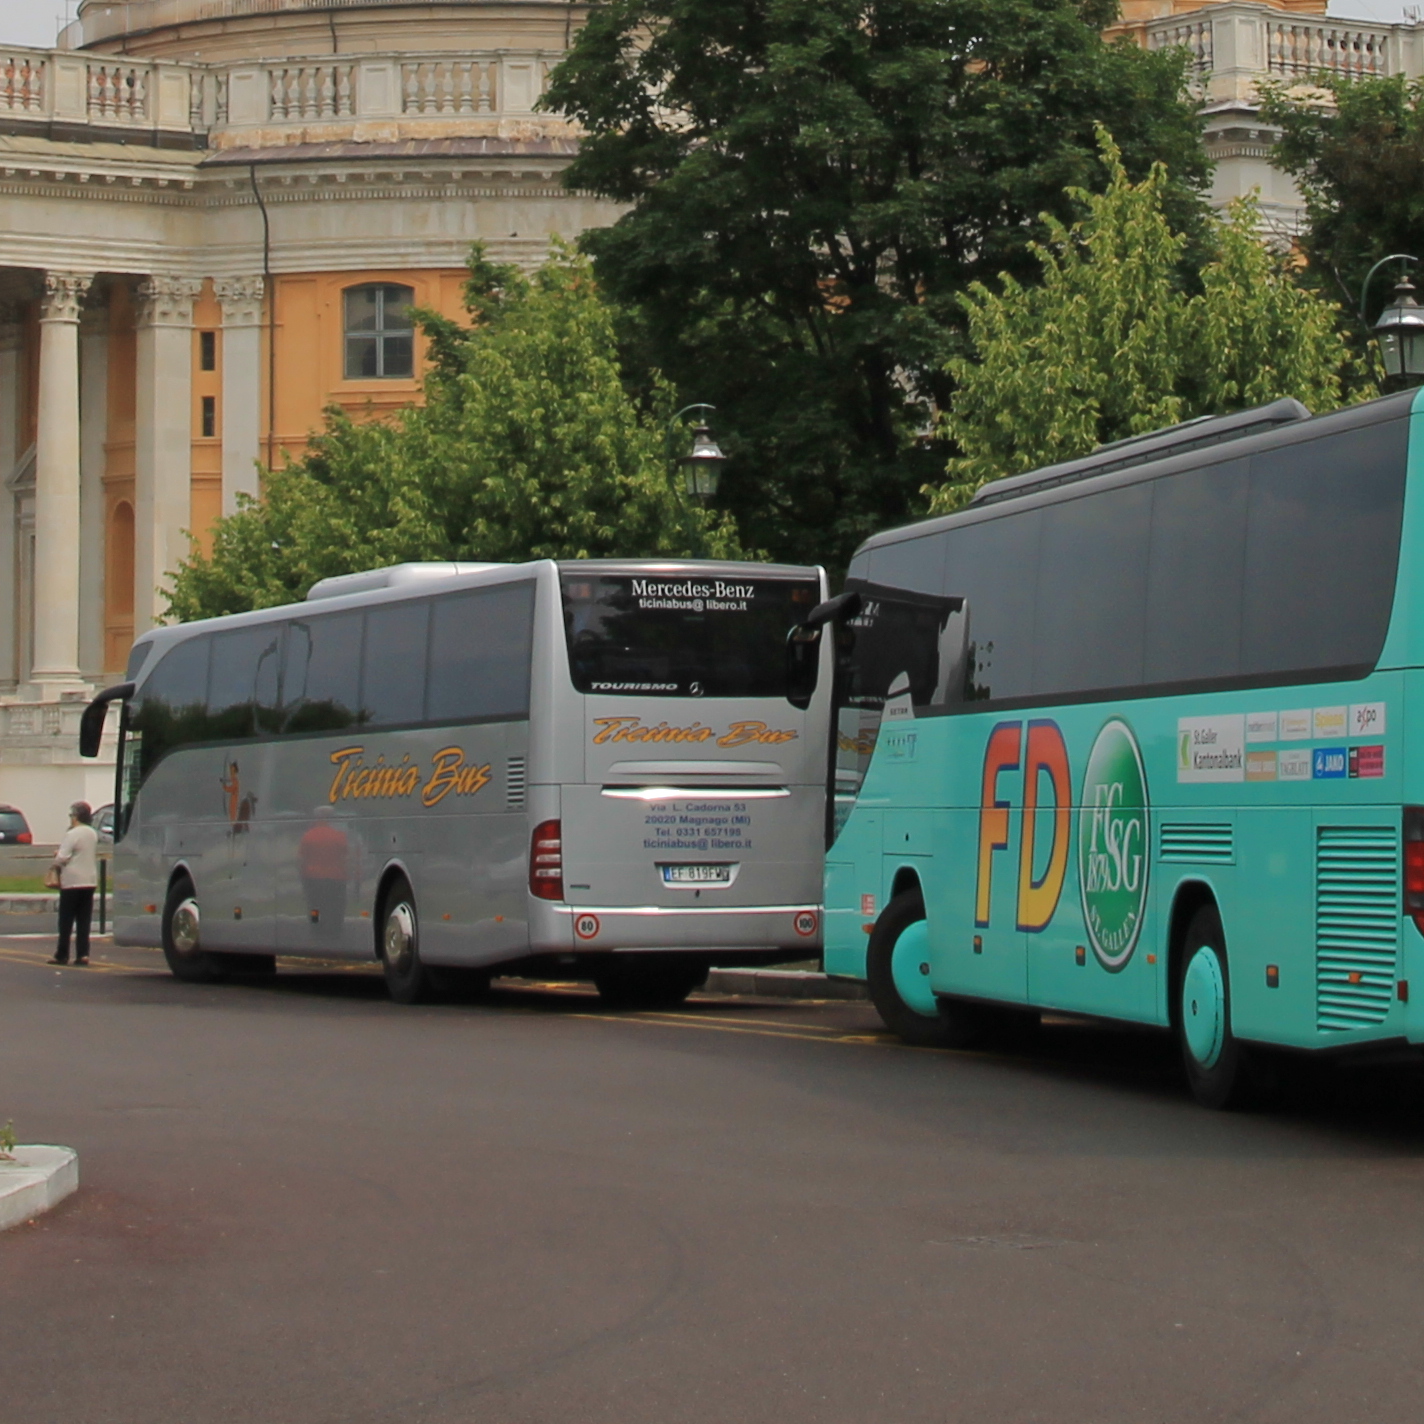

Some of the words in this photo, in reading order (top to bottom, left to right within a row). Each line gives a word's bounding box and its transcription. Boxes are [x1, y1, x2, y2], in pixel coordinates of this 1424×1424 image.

[631, 579, 755, 598] Mercedes-Benz
[591, 681, 678, 691] TOURISMO
[593, 717, 716, 744] Ticinia
[716, 721, 799, 749] Bus
[1194, 748, 1243, 769] Kantonalbank
[1325, 754, 1344, 772] JAKO
[329, 745, 420, 804] Ticinia
[422, 745, 492, 807] Bus
[650, 803, 666, 812] Via
[685, 803, 731, 812] Cadorna
[645, 815, 676, 824] 20020
[679, 815, 728, 826] Magnago
[975, 718, 1072, 933] FD
[581, 921, 594, 932] 80
